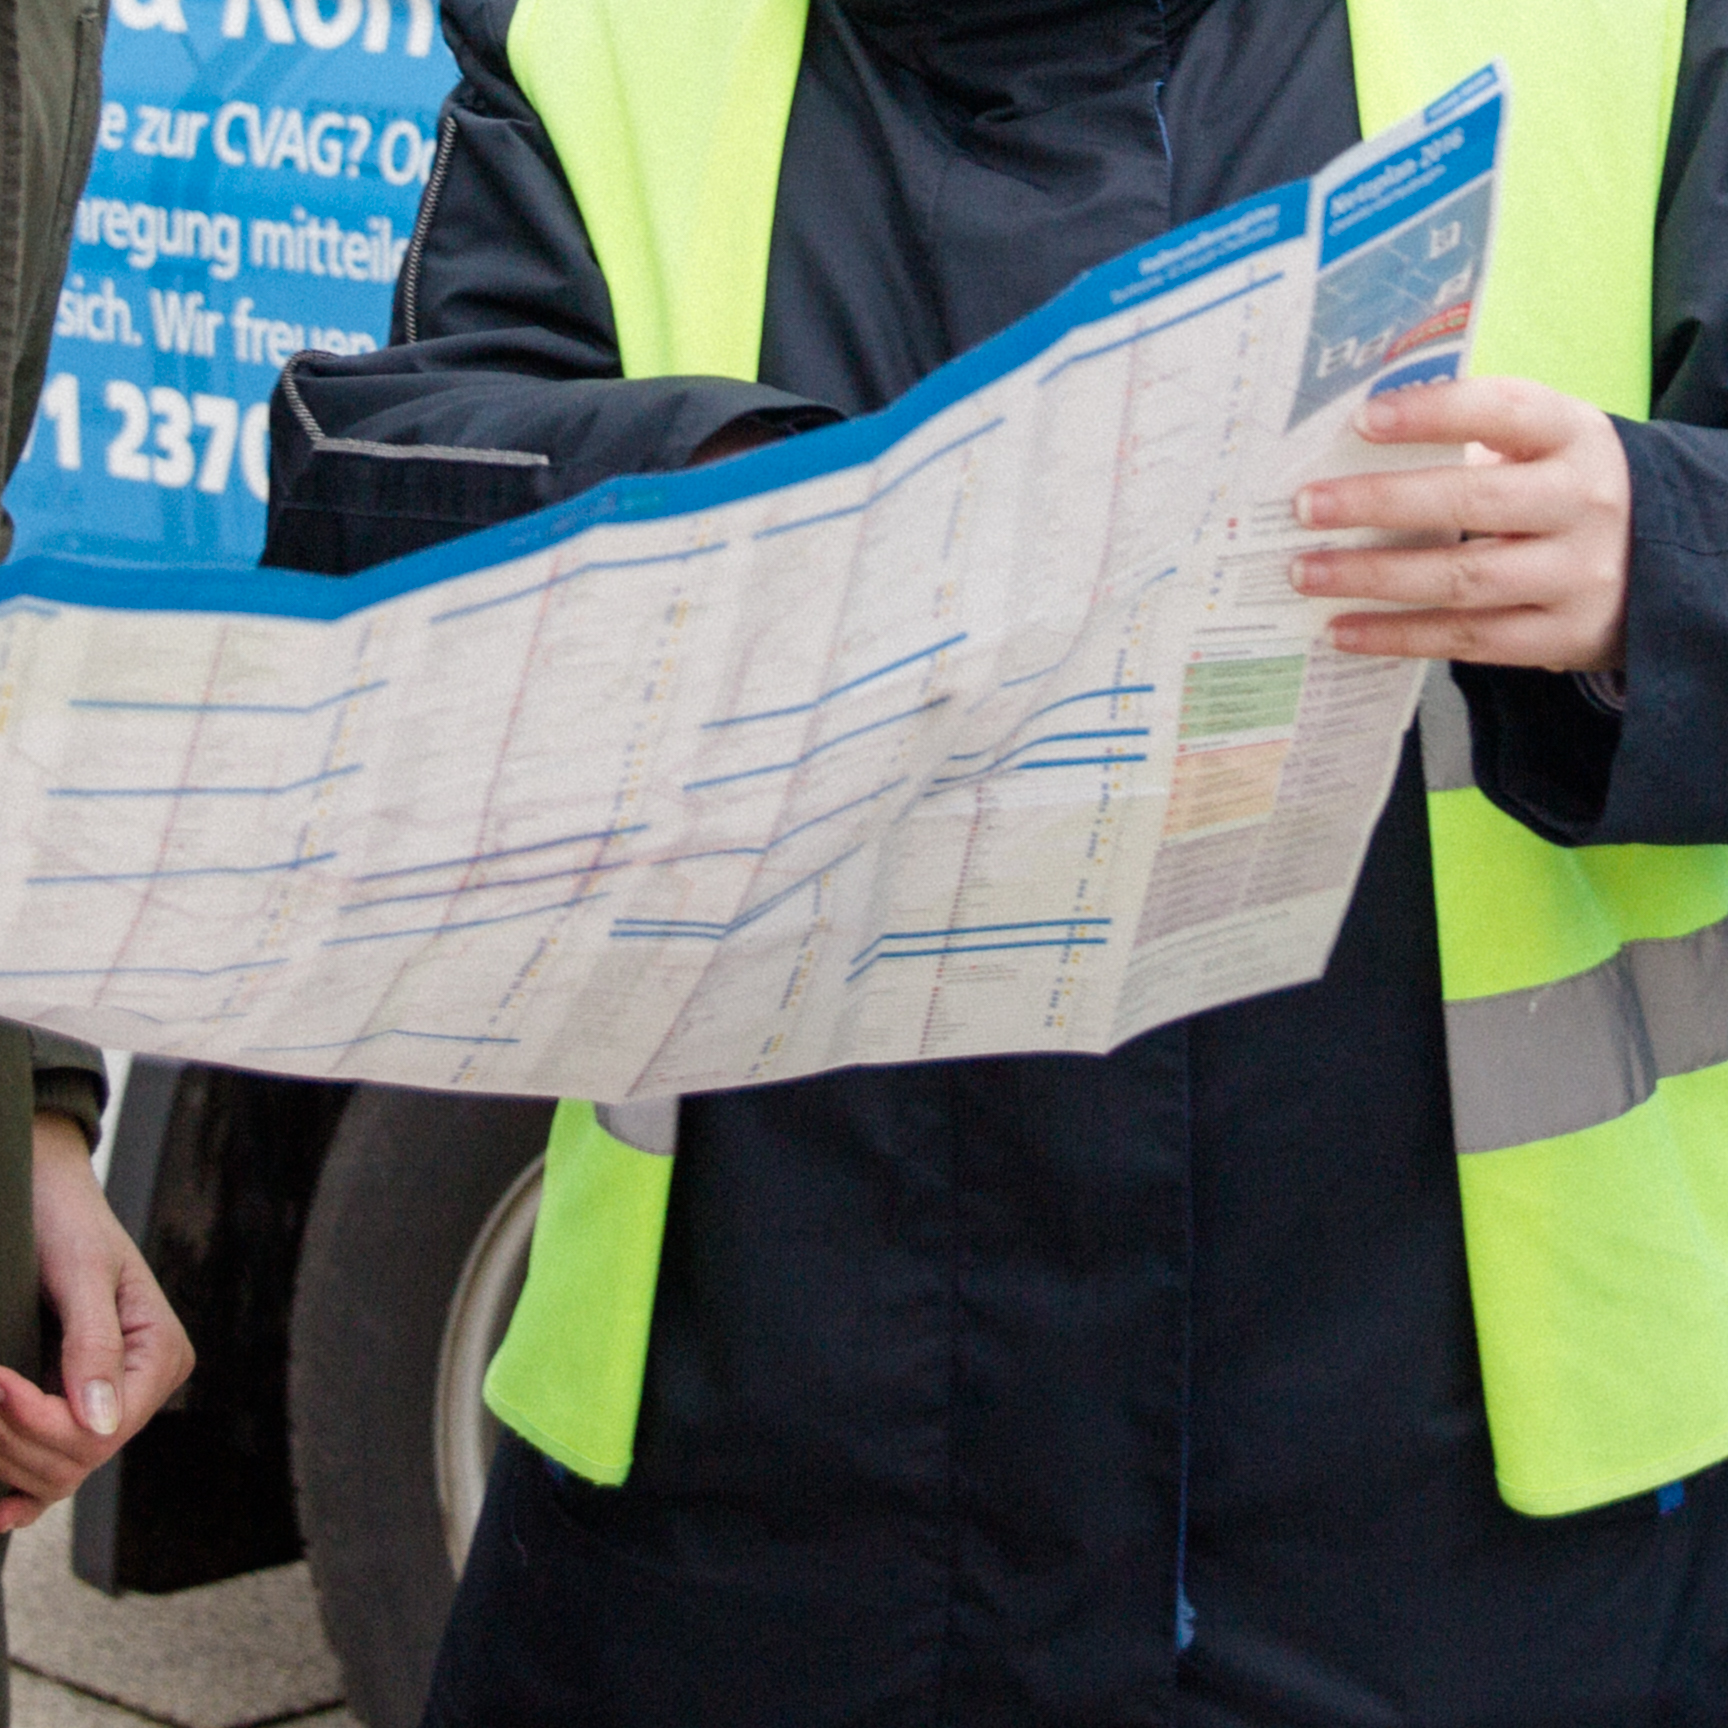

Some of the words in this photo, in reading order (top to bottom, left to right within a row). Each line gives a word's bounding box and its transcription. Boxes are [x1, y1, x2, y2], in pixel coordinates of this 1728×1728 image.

[132, 104, 210, 160] zur
[212, 99, 371, 179] CVAG?
[148, 287, 224, 358] Wir
